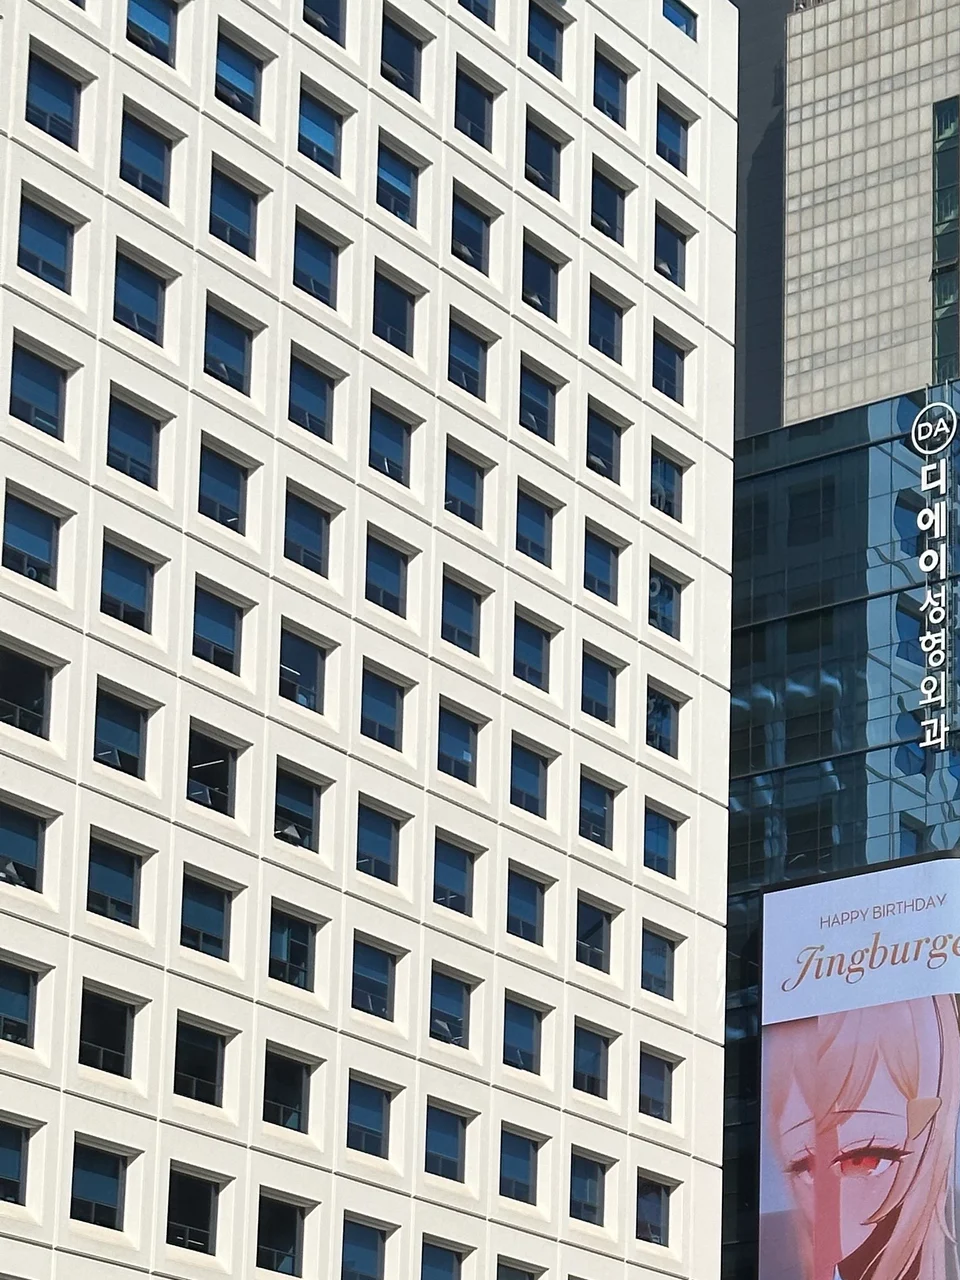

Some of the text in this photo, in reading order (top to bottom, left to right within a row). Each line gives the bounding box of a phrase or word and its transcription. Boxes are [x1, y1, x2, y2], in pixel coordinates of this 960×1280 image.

[915, 462, 950, 751] 디에이성형외과
[819, 892, 947, 930] HAPPY BIRTHDAY
